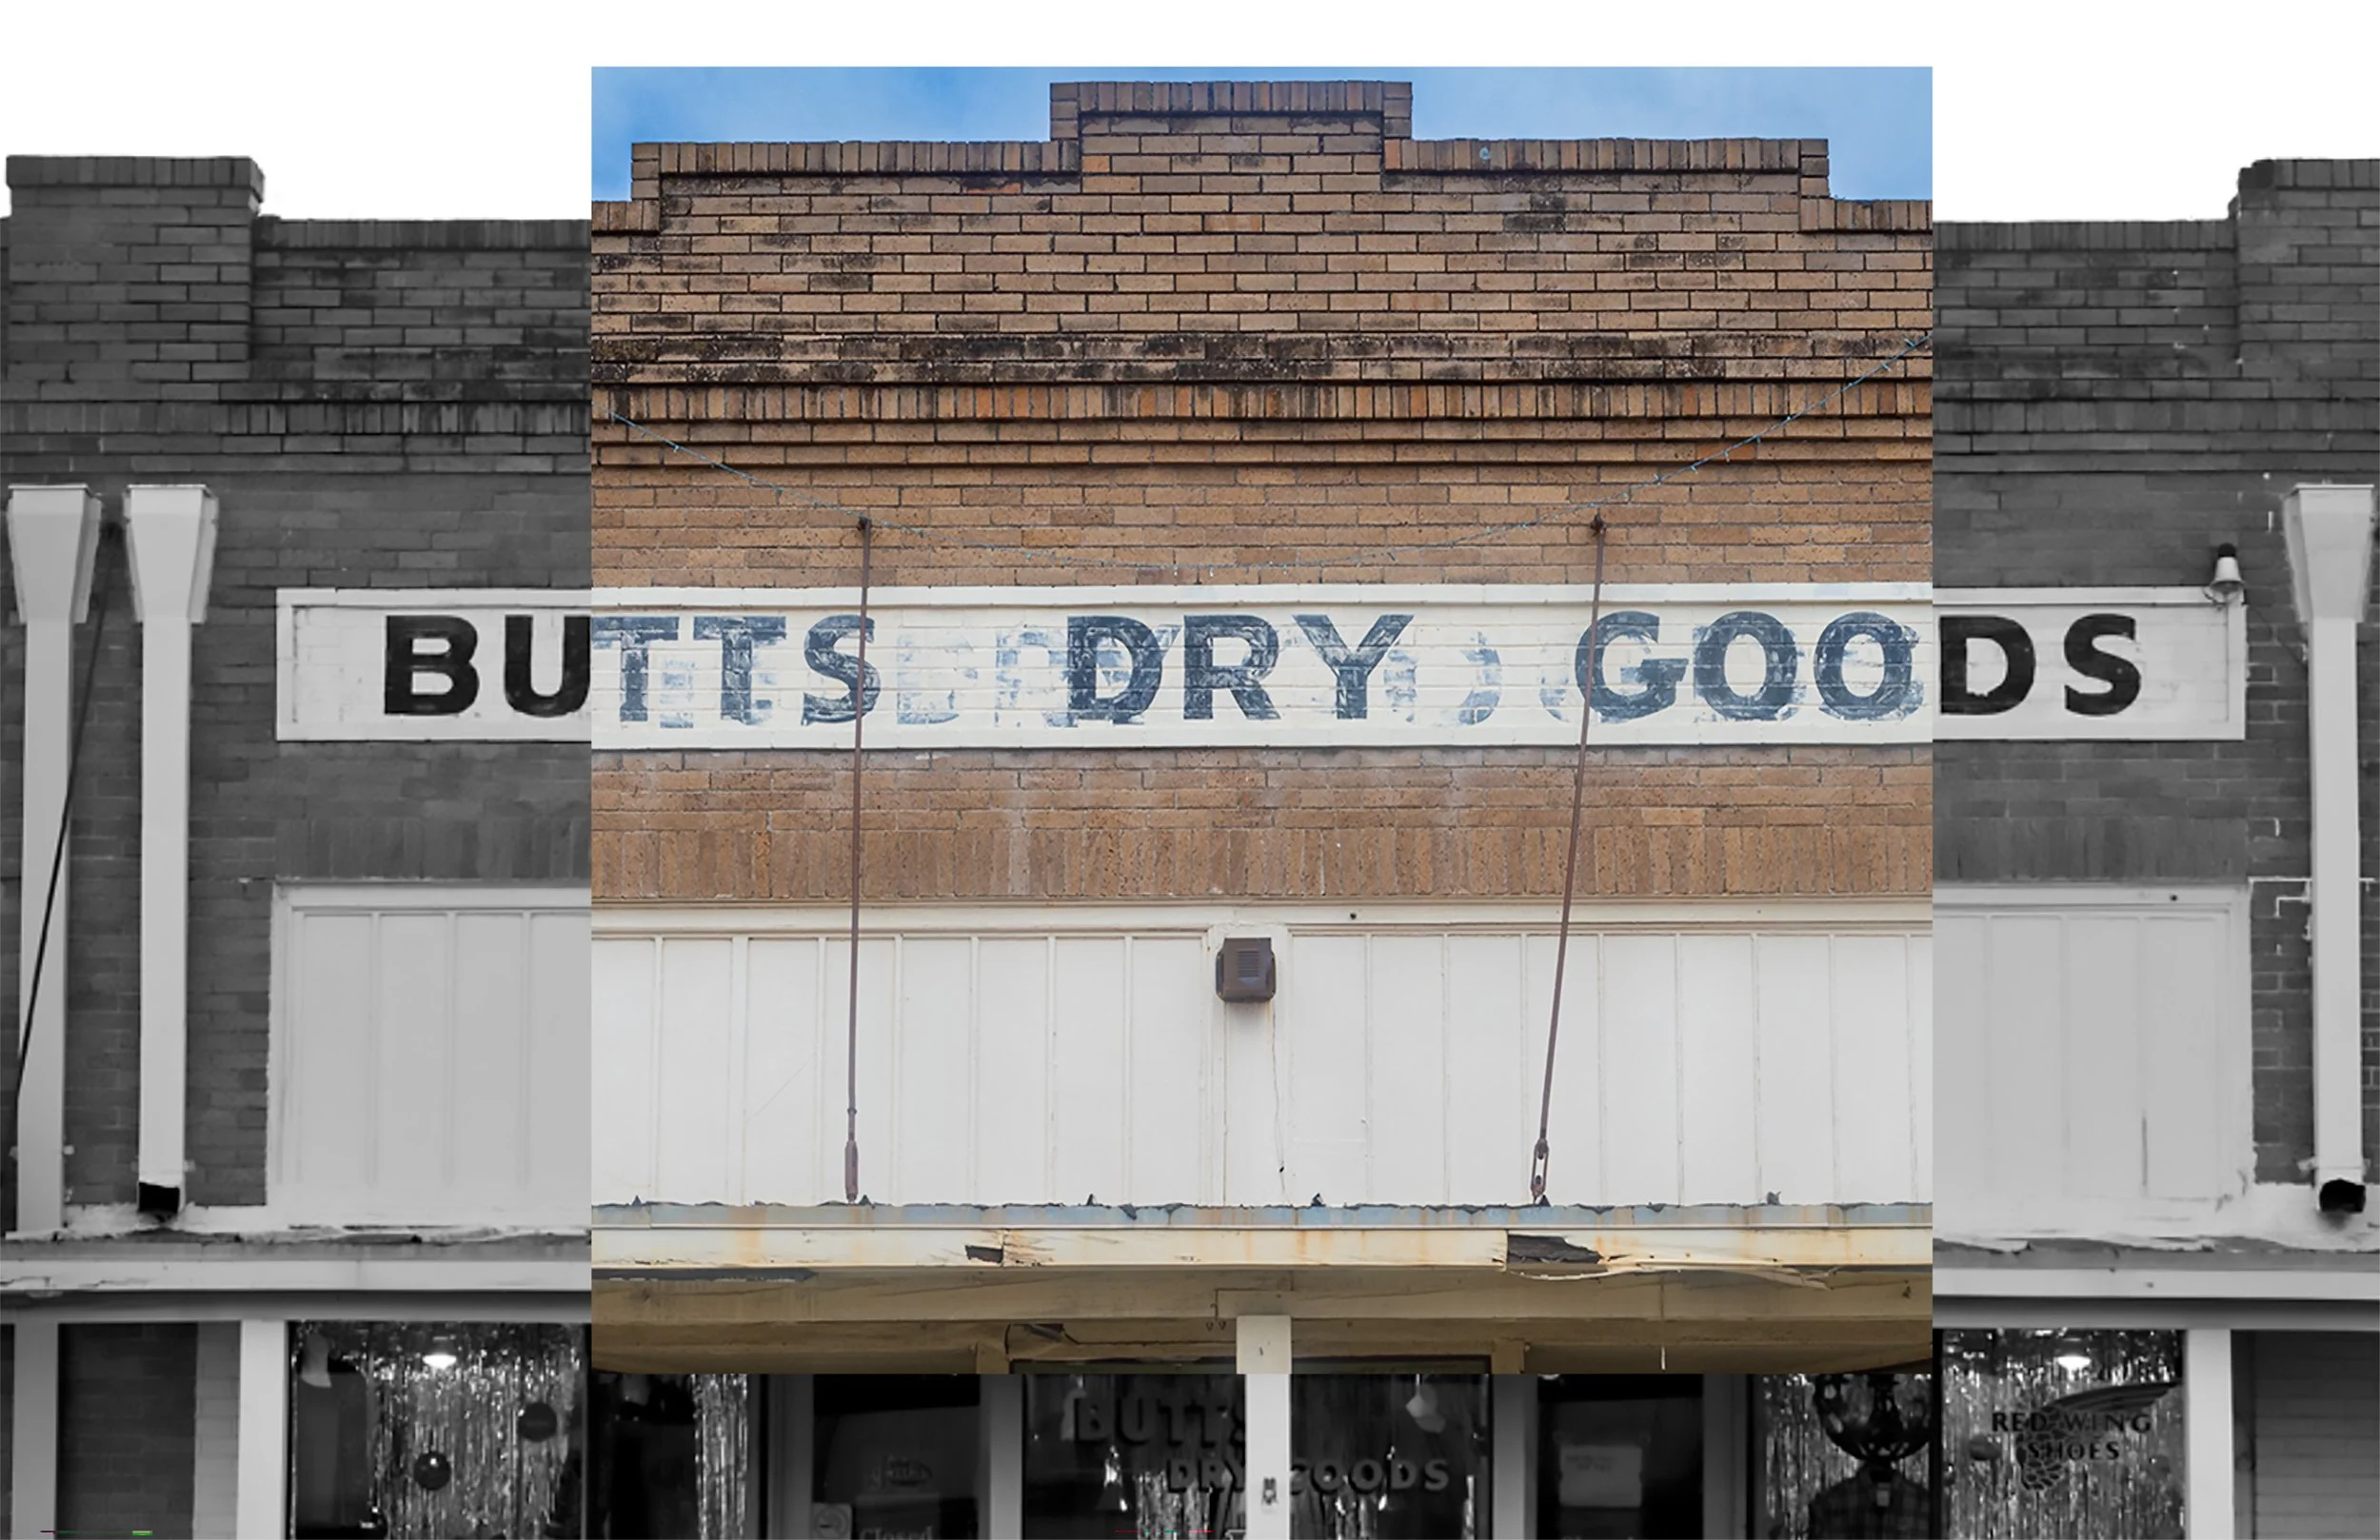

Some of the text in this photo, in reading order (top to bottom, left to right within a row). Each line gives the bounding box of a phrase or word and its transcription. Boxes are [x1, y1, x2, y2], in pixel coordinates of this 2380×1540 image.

[384, 614, 881, 726] BUTTS
[1066, 614, 1415, 721] DRY
[1575, 610, 2142, 721] GOODS
[1992, 1412, 2152, 1433] RED WING
[2027, 1440, 2120, 1461] SHOES
